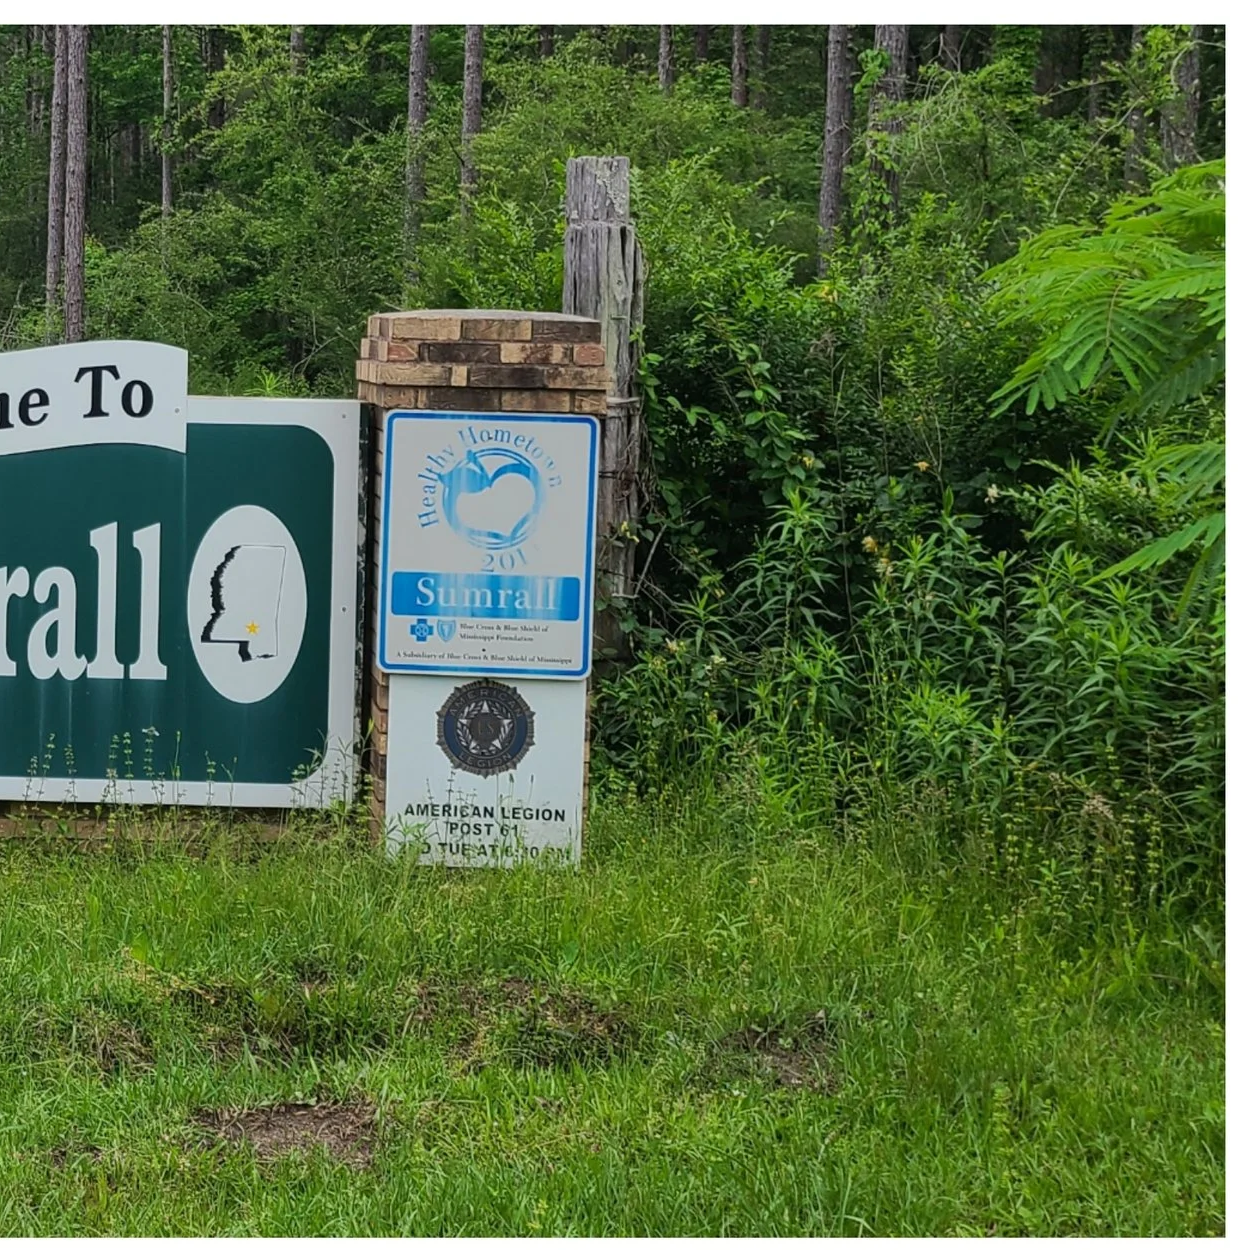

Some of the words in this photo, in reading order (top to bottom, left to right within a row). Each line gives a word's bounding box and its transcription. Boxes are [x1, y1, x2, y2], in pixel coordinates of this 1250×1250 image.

[74, 365, 154, 419] To
[417, 444, 455, 528] Healthy
[416, 577, 557, 610] Sumrall
[449, 688, 523, 716] AMERICAN
[459, 752, 512, 768] LEGION
[404, 803, 495, 819] AMERICAN
[501, 806, 566, 822] LEGION
[449, 822, 495, 836] POST
[500, 824, 519, 838] 61
[438, 842, 471, 855] TUE
[476, 844, 499, 857] AT
